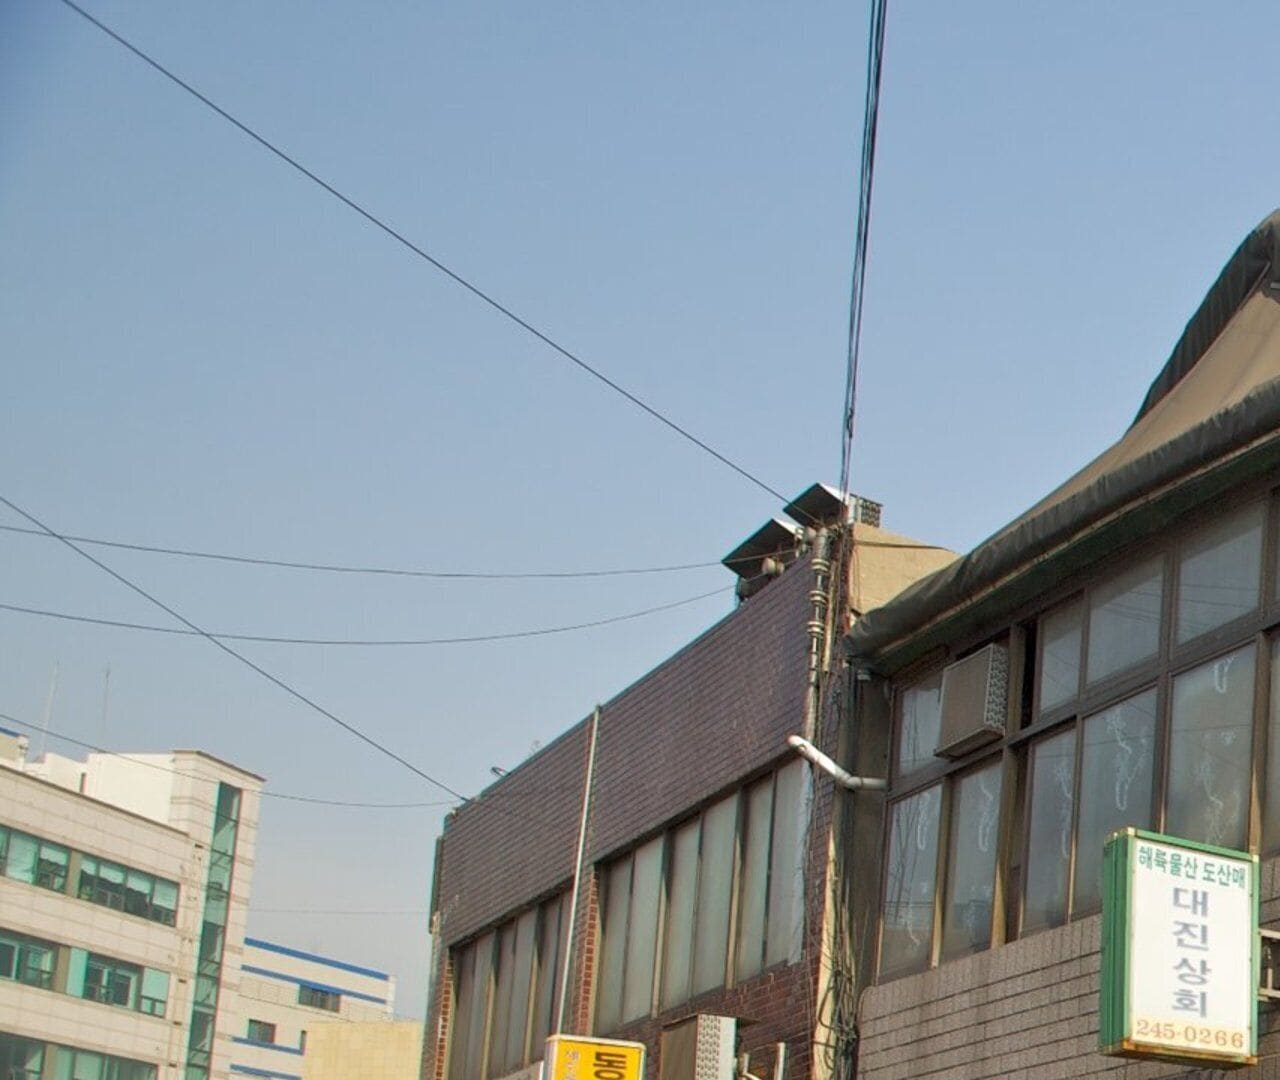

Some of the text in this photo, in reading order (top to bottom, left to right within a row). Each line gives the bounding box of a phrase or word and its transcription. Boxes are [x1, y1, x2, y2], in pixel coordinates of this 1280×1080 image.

[1139, 845, 1246, 889] 해륙물산 도산매
[1172, 887, 1212, 1018] 대진상회
[1136, 1019, 1244, 1049] 245-0266
